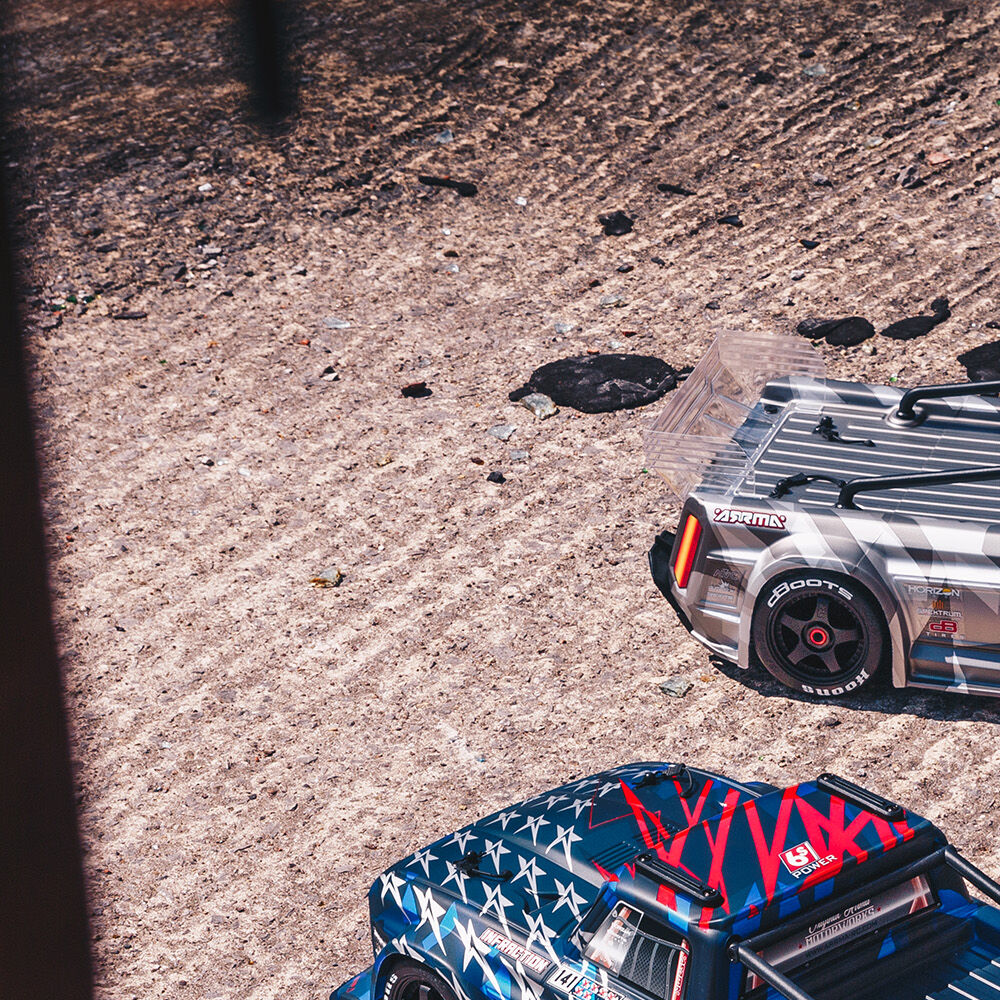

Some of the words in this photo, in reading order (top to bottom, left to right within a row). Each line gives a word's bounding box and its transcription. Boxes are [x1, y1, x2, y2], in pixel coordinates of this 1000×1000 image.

[714, 508, 786, 529] ARRMA
[908, 584, 960, 597] HORIZON
[792, 854, 838, 879] POWER
[480, 928, 551, 974] INFRACTION
[554, 969, 578, 993] 141
